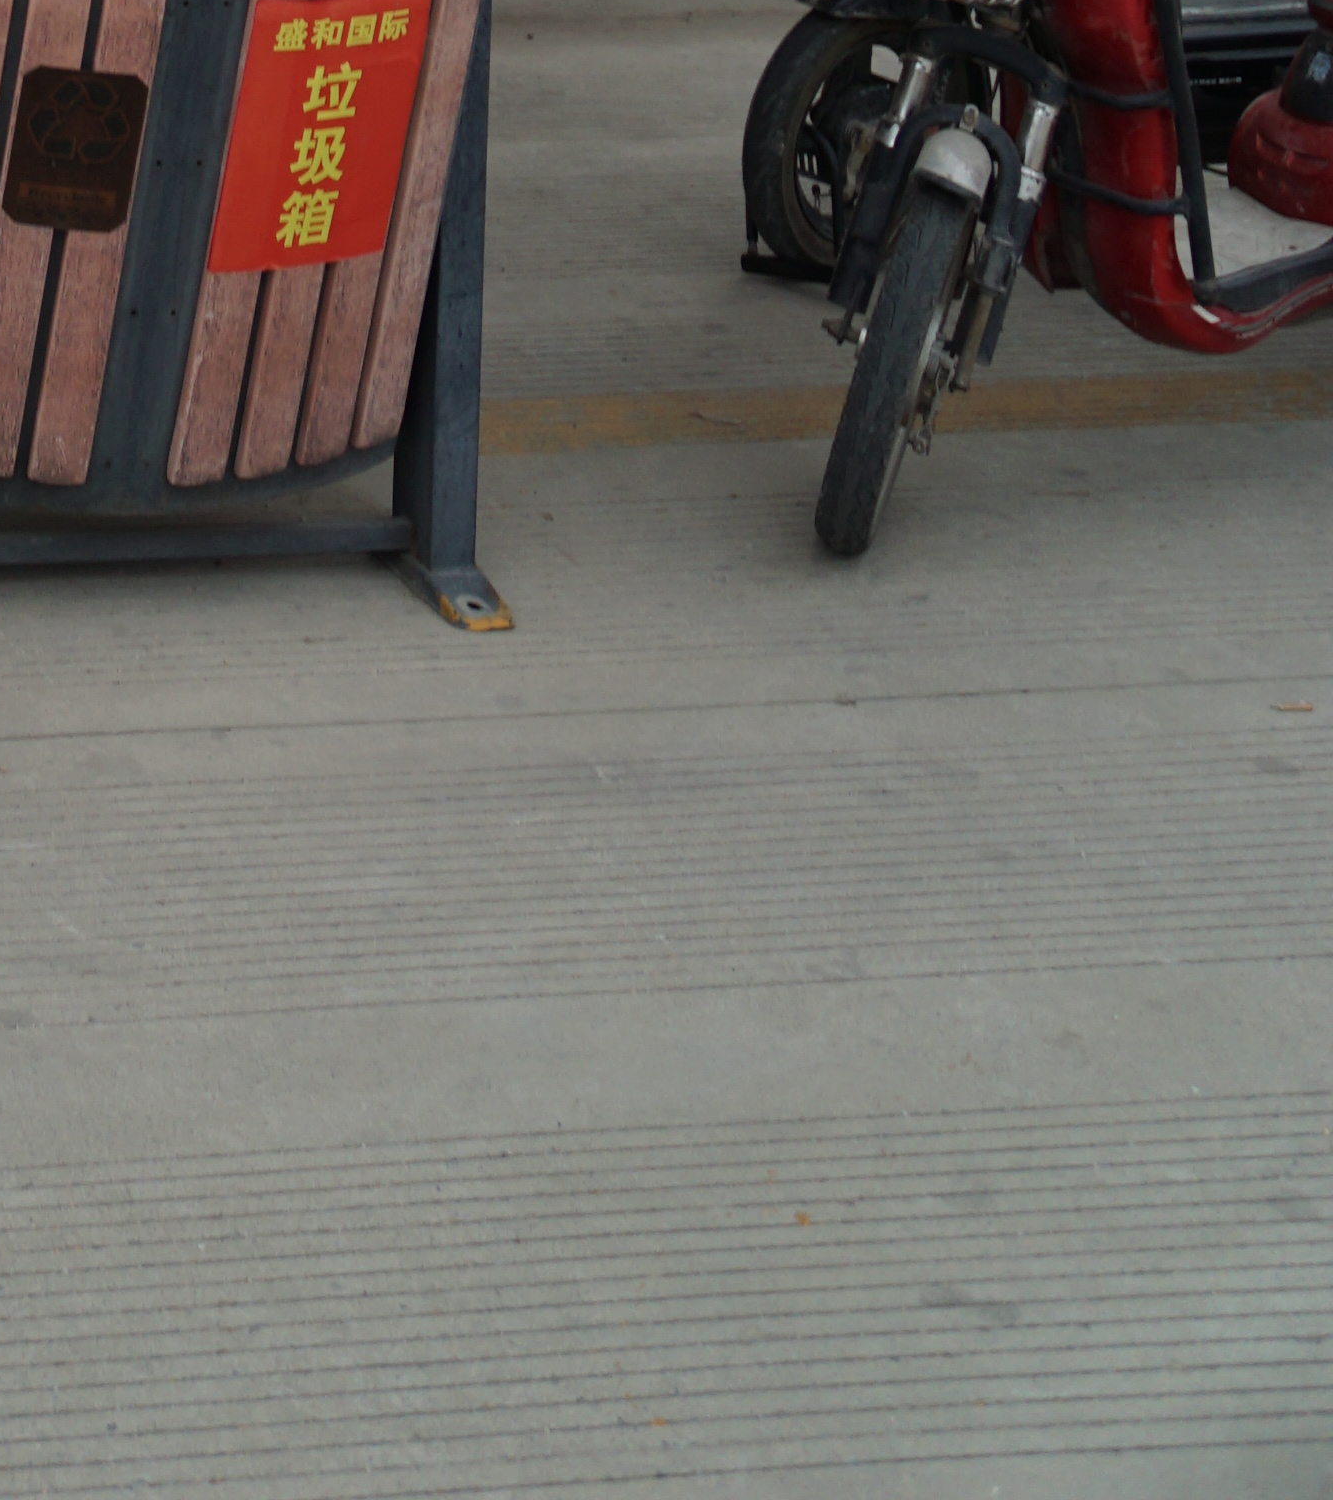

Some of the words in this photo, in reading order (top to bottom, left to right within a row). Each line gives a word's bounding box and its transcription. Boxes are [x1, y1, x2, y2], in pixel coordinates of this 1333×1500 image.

[273, 8, 410, 52] 盛和国际
[275, 61, 363, 248] 垃圾箱
